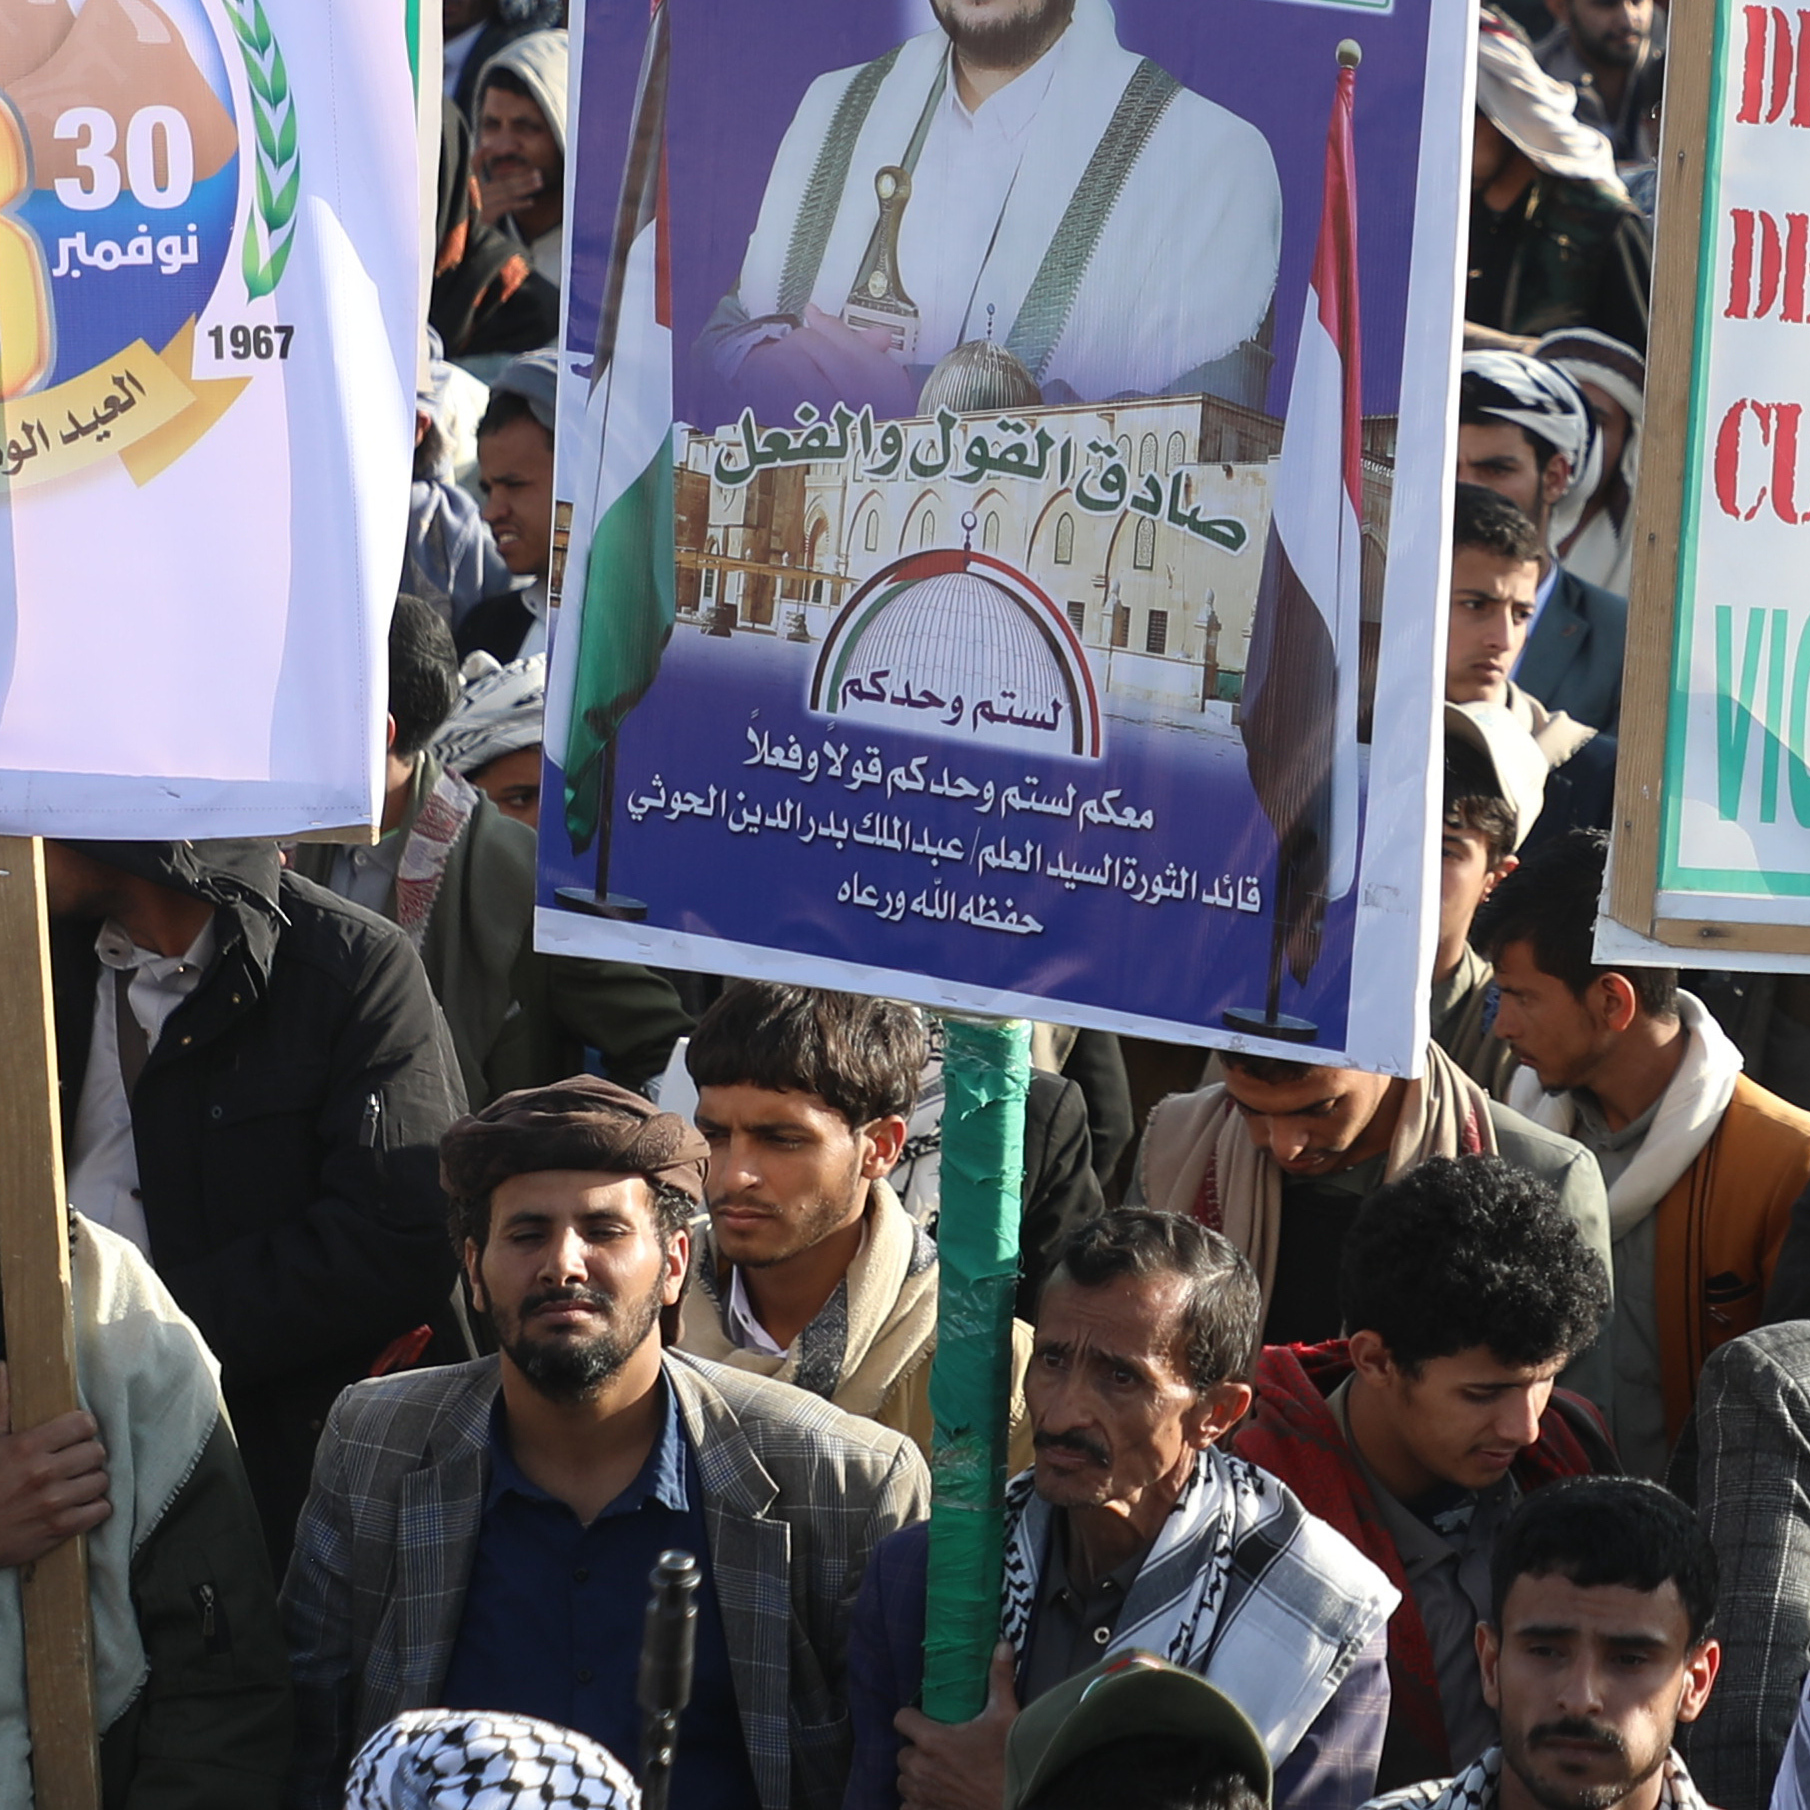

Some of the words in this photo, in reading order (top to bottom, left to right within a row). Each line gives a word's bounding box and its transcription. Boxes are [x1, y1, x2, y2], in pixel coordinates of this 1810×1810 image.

[53, 104, 194, 211] 30
[52, 222, 199, 279] نوفمبر
[208, 324, 295, 361] 1967
[59, 368, 147, 446] العيد
[713, 400, 901, 486] والفعل
[909, 405, 1075, 486] القول
[1076, 437, 1250, 555] صادق
[840, 667, 965, 727] وحدكم
[971, 689, 1064, 733] لستم
[626, 772, 727, 822] الحوثي
[885, 756, 996, 814] وحدكم
[999, 773, 1076, 820] لستم
[1078, 789, 1154, 833] معكم
[1046, 838, 1121, 891] السيد
[1120, 852, 1198, 906] الثورة
[836, 871, 907, 922] ورعاه
[910, 874, 957, 924] الله
[958, 892, 1045, 936] حفظه
[1202, 874, 1262, 915] قائد
